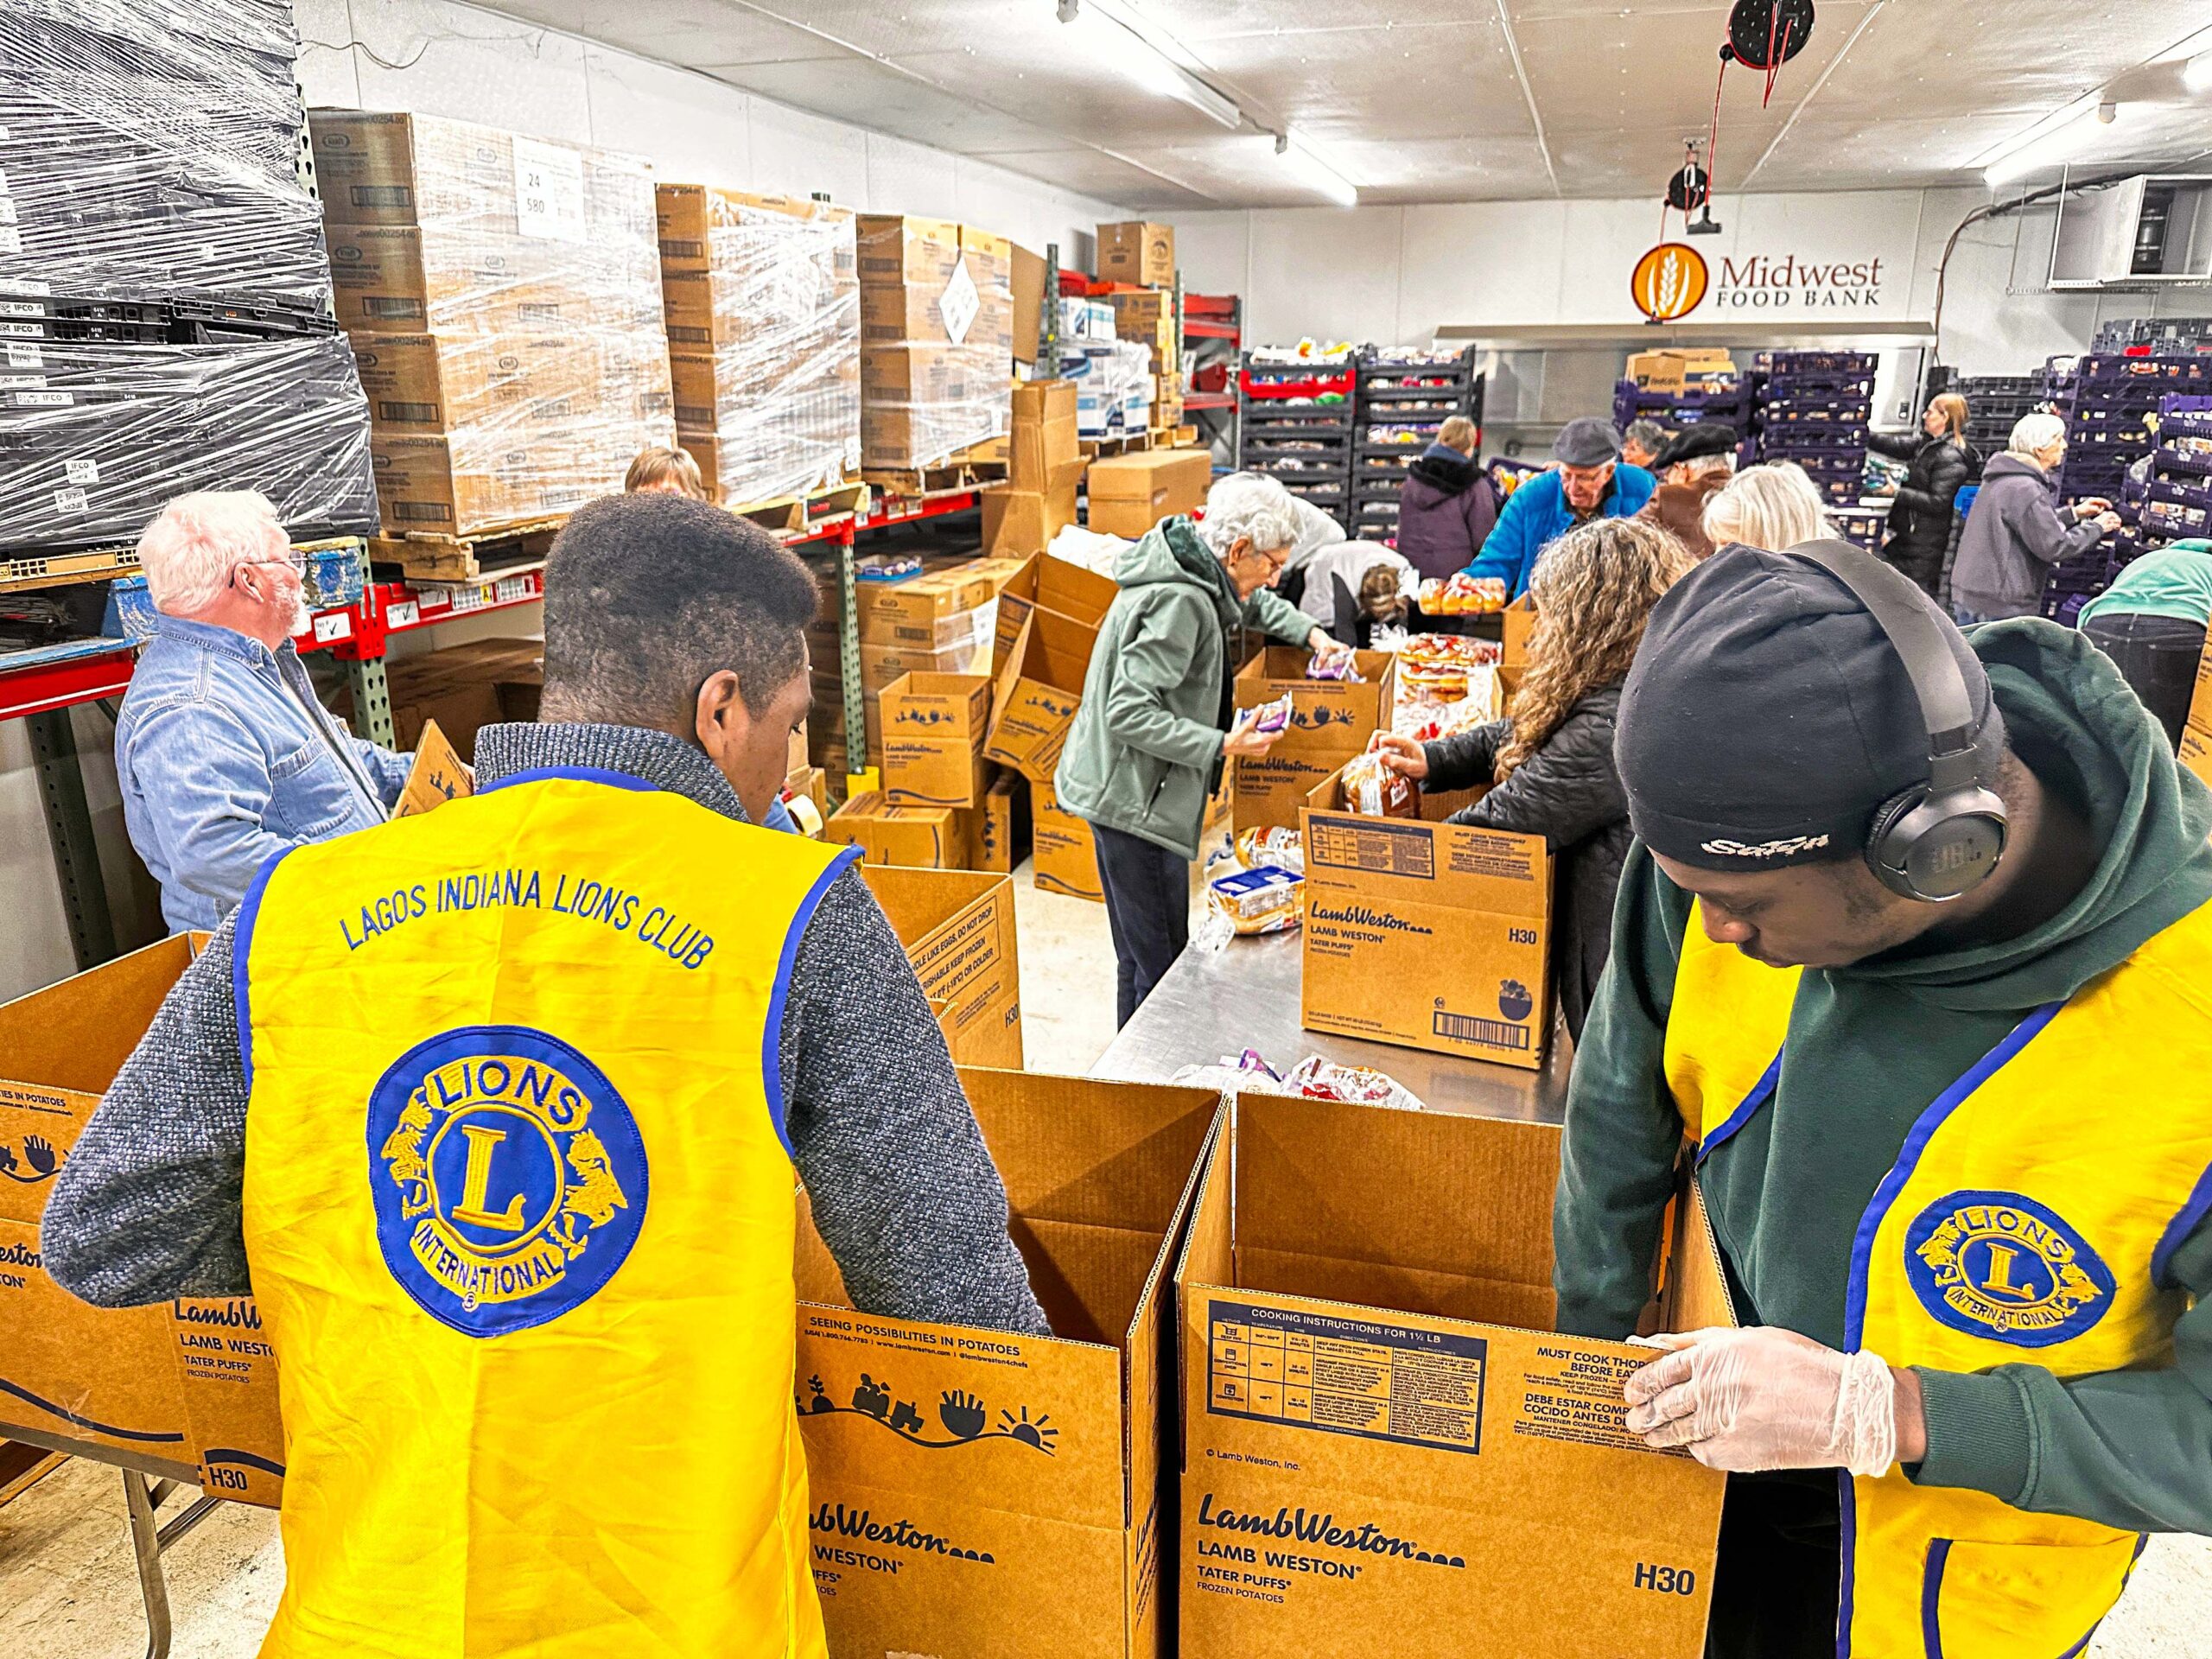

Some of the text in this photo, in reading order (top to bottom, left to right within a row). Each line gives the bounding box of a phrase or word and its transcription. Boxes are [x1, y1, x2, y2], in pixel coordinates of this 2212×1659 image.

[529, 173, 540, 187] 24
[528, 198, 544, 213] 580
[1718, 254, 1883, 288] Midwest
[1717, 289, 1880, 307] FOOD BANK
[340, 869, 714, 969] LAGOS INDIANA LIONS CLUB
[927, 945, 939, 963] LIKE
[957, 927, 966, 938] DO
[967, 919, 977, 932] NOT
[978, 906, 992, 926] DROP
[1311, 925, 1338, 937] LAMB
[1509, 928, 1536, 944] H30
[950, 953, 965, 969] KEEP
[966, 936, 986, 958] FROZEN
[964, 964, 972, 977] OR
[973, 948, 993, 970] COLDER
[1006, 1003, 1019, 1027] H30
[26, 1093, 66, 1107] POTATOES
[434, 1060, 581, 1124] LIONS
[452, 1124, 526, 1231] L
[1962, 1210, 2068, 1258] LIONS
[414, 1224, 564, 1295] INTERNATIONAL
[1981, 1243, 2035, 1301] L
[1948, 1288, 2063, 1326] INTERNATIONAL
[810, 1317, 1020, 1357] SEEING POSSIBILITIES IN POTATOES
[1251, 1308, 1300, 1323] COOKING
[1303, 1315, 1381, 1334] INSTRUCTIONS
[1384, 1328, 1406, 1339] FOR
[1427, 1334, 1441, 1343] LB
[181, 1333, 223, 1350] LAMB
[184, 1355, 215, 1367] TATER
[876, 1341, 950, 1357] www.lambweston.com
[959, 1352, 1028, 1369] @lambweston4chefs
[1537, 1347, 1570, 1359] MUST
[1574, 1352, 1609, 1365] COOK
[188, 1369, 250, 1383] FROZEN POTATOES
[1571, 1363, 1612, 1376] BEFORE
[1580, 1374, 1608, 1383] FROZEN
[1525, 1393, 1553, 1404] DEBE
[1556, 1397, 1591, 1410] ESTAR
[1523, 1403, 1610, 1424] COCIDO ANTES
[1534, 1415, 1570, 1426] MANTENER
[1217, 1450, 1243, 1462] Lamb
[1245, 1454, 1281, 1469] Weston,
[1284, 1461, 1300, 1471] Inc.
[209, 1466, 248, 1491] H30
[1198, 1540, 1255, 1563] LAMB
[1198, 1565, 1239, 1582] TATER
[1635, 1563, 1694, 1595] H30
[1197, 1581, 1284, 1604] FROZEN POTATOES
